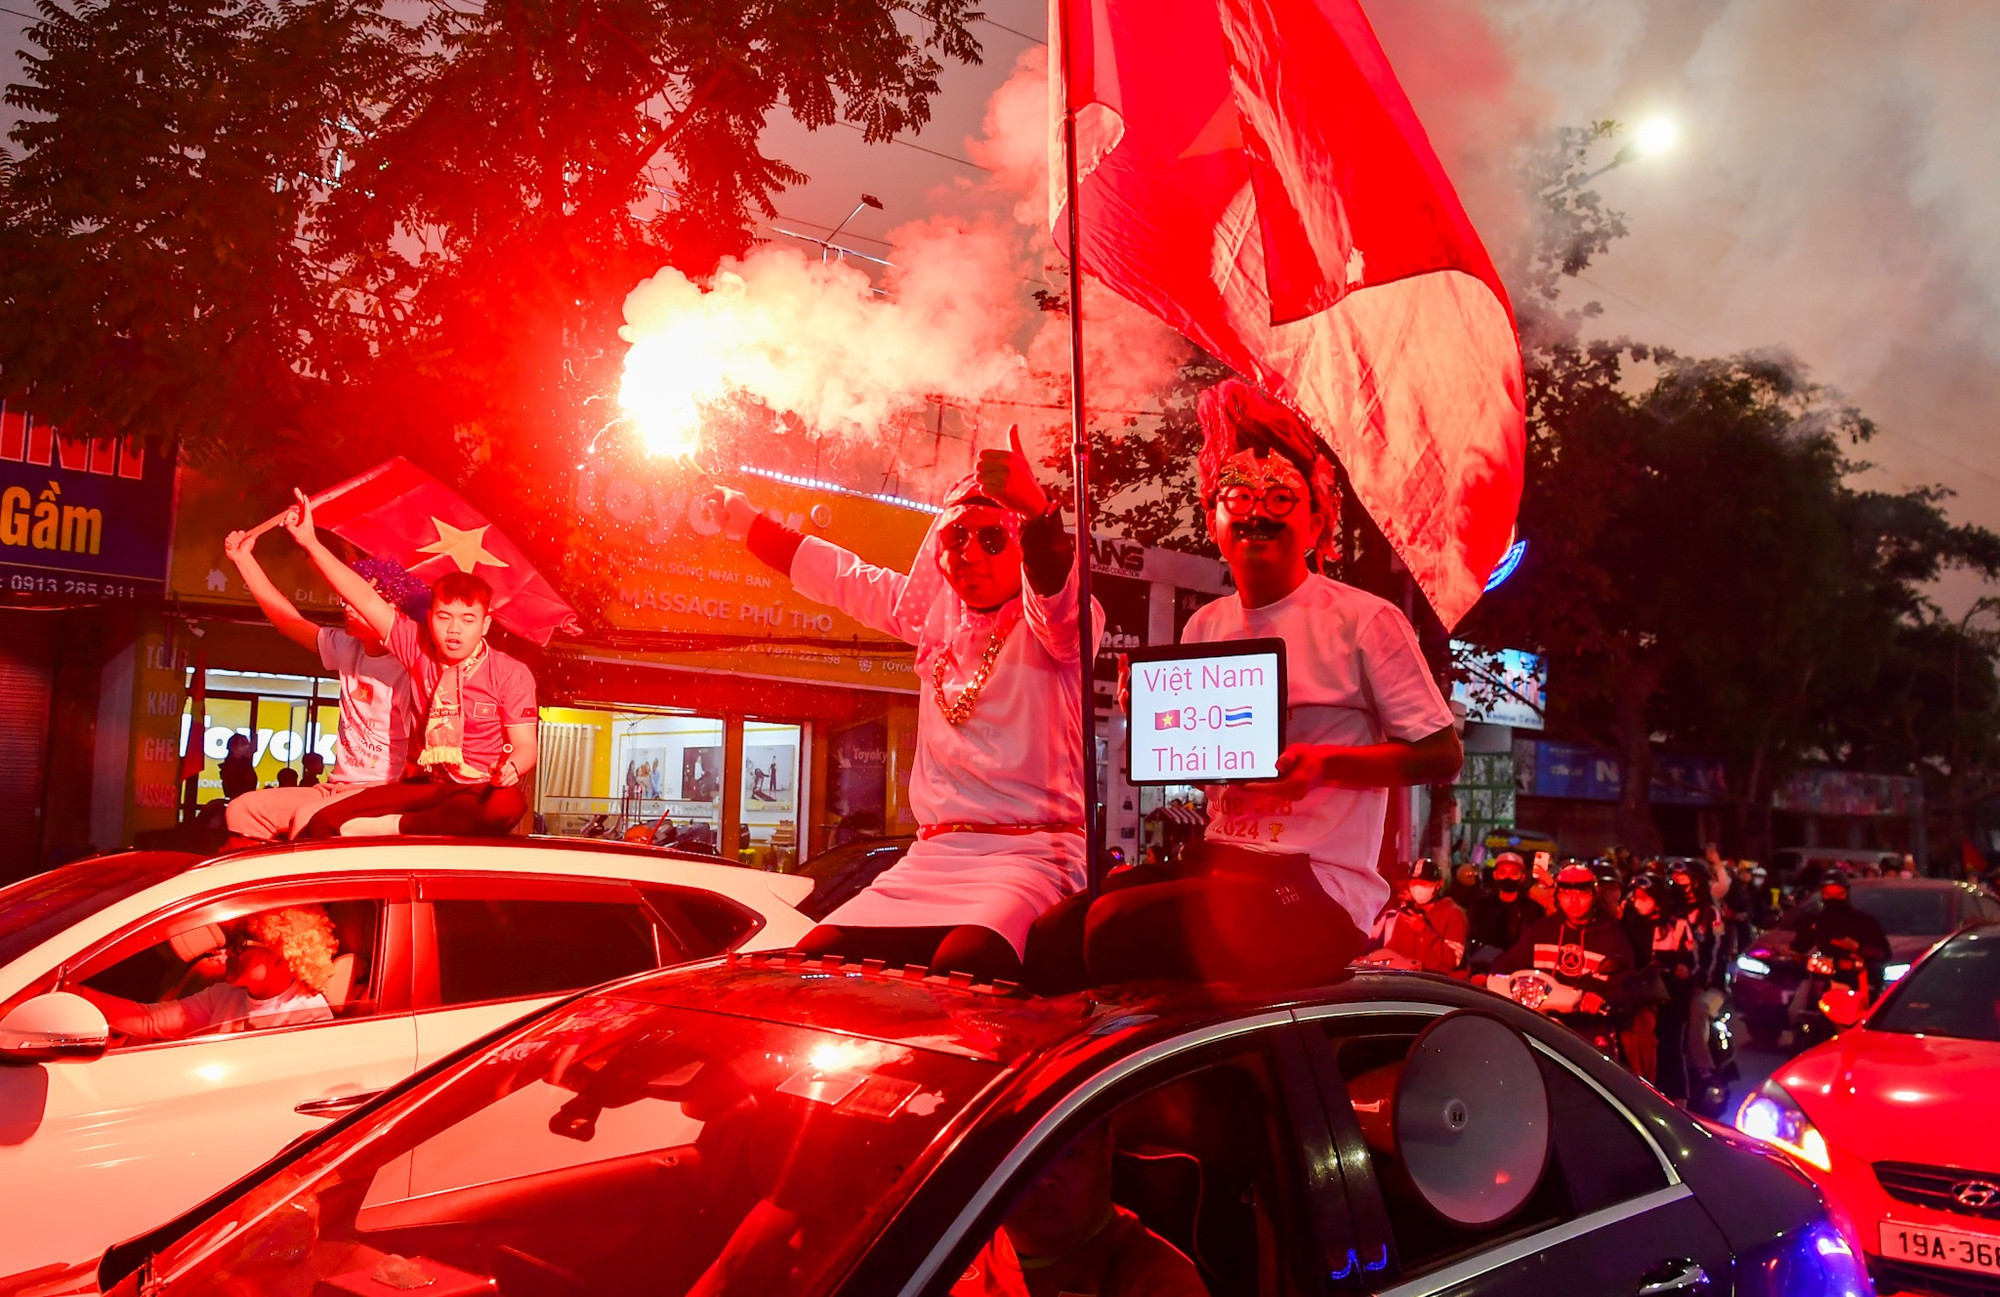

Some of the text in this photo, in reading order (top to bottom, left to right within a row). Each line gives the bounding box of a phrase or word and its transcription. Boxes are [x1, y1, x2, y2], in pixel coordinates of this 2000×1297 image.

[0, 481, 103, 555] Gầm
[11, 574, 58, 592] 0913
[64, 580, 98, 595] 285
[619, 586, 833, 639] MASSAGE PHÚ THỌ
[1143, 664, 1264, 696] Việt Nam
[147, 691, 177, 717] KHO
[1183, 705, 1222, 731] 3-0
[1152, 745, 1255, 772] Thái lan
[134, 783, 177, 808] MASSAGE
